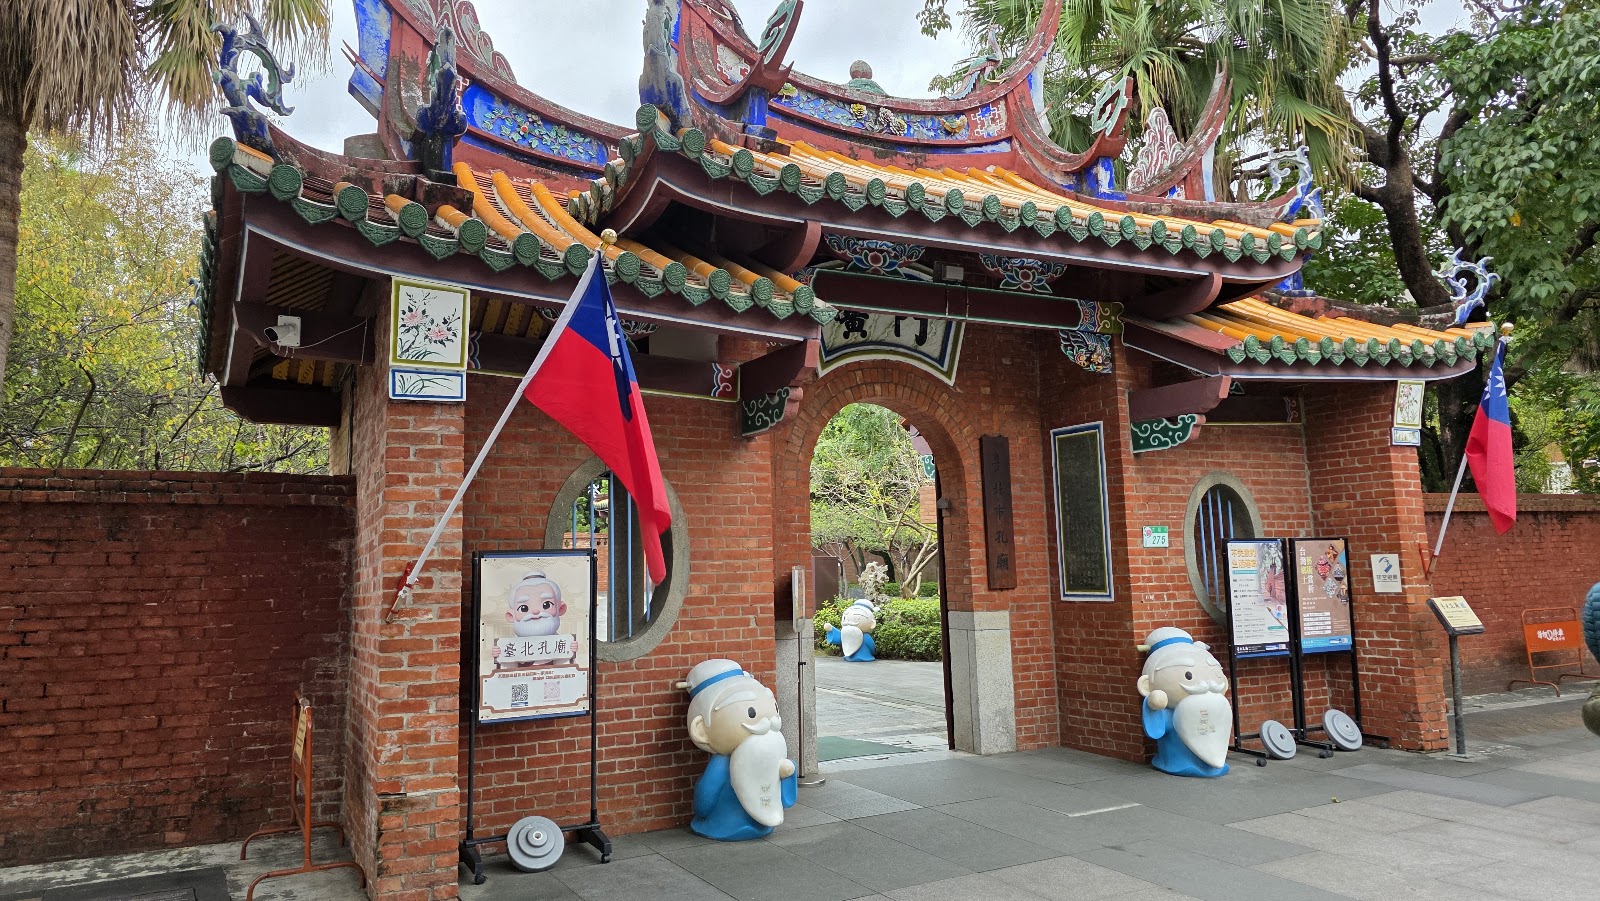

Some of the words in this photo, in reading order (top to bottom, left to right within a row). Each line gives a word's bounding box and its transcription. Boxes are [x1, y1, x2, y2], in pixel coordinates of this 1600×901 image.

[1152, 535, 1166, 545] 275
[504, 639, 567, 657] 臺北孔廟
